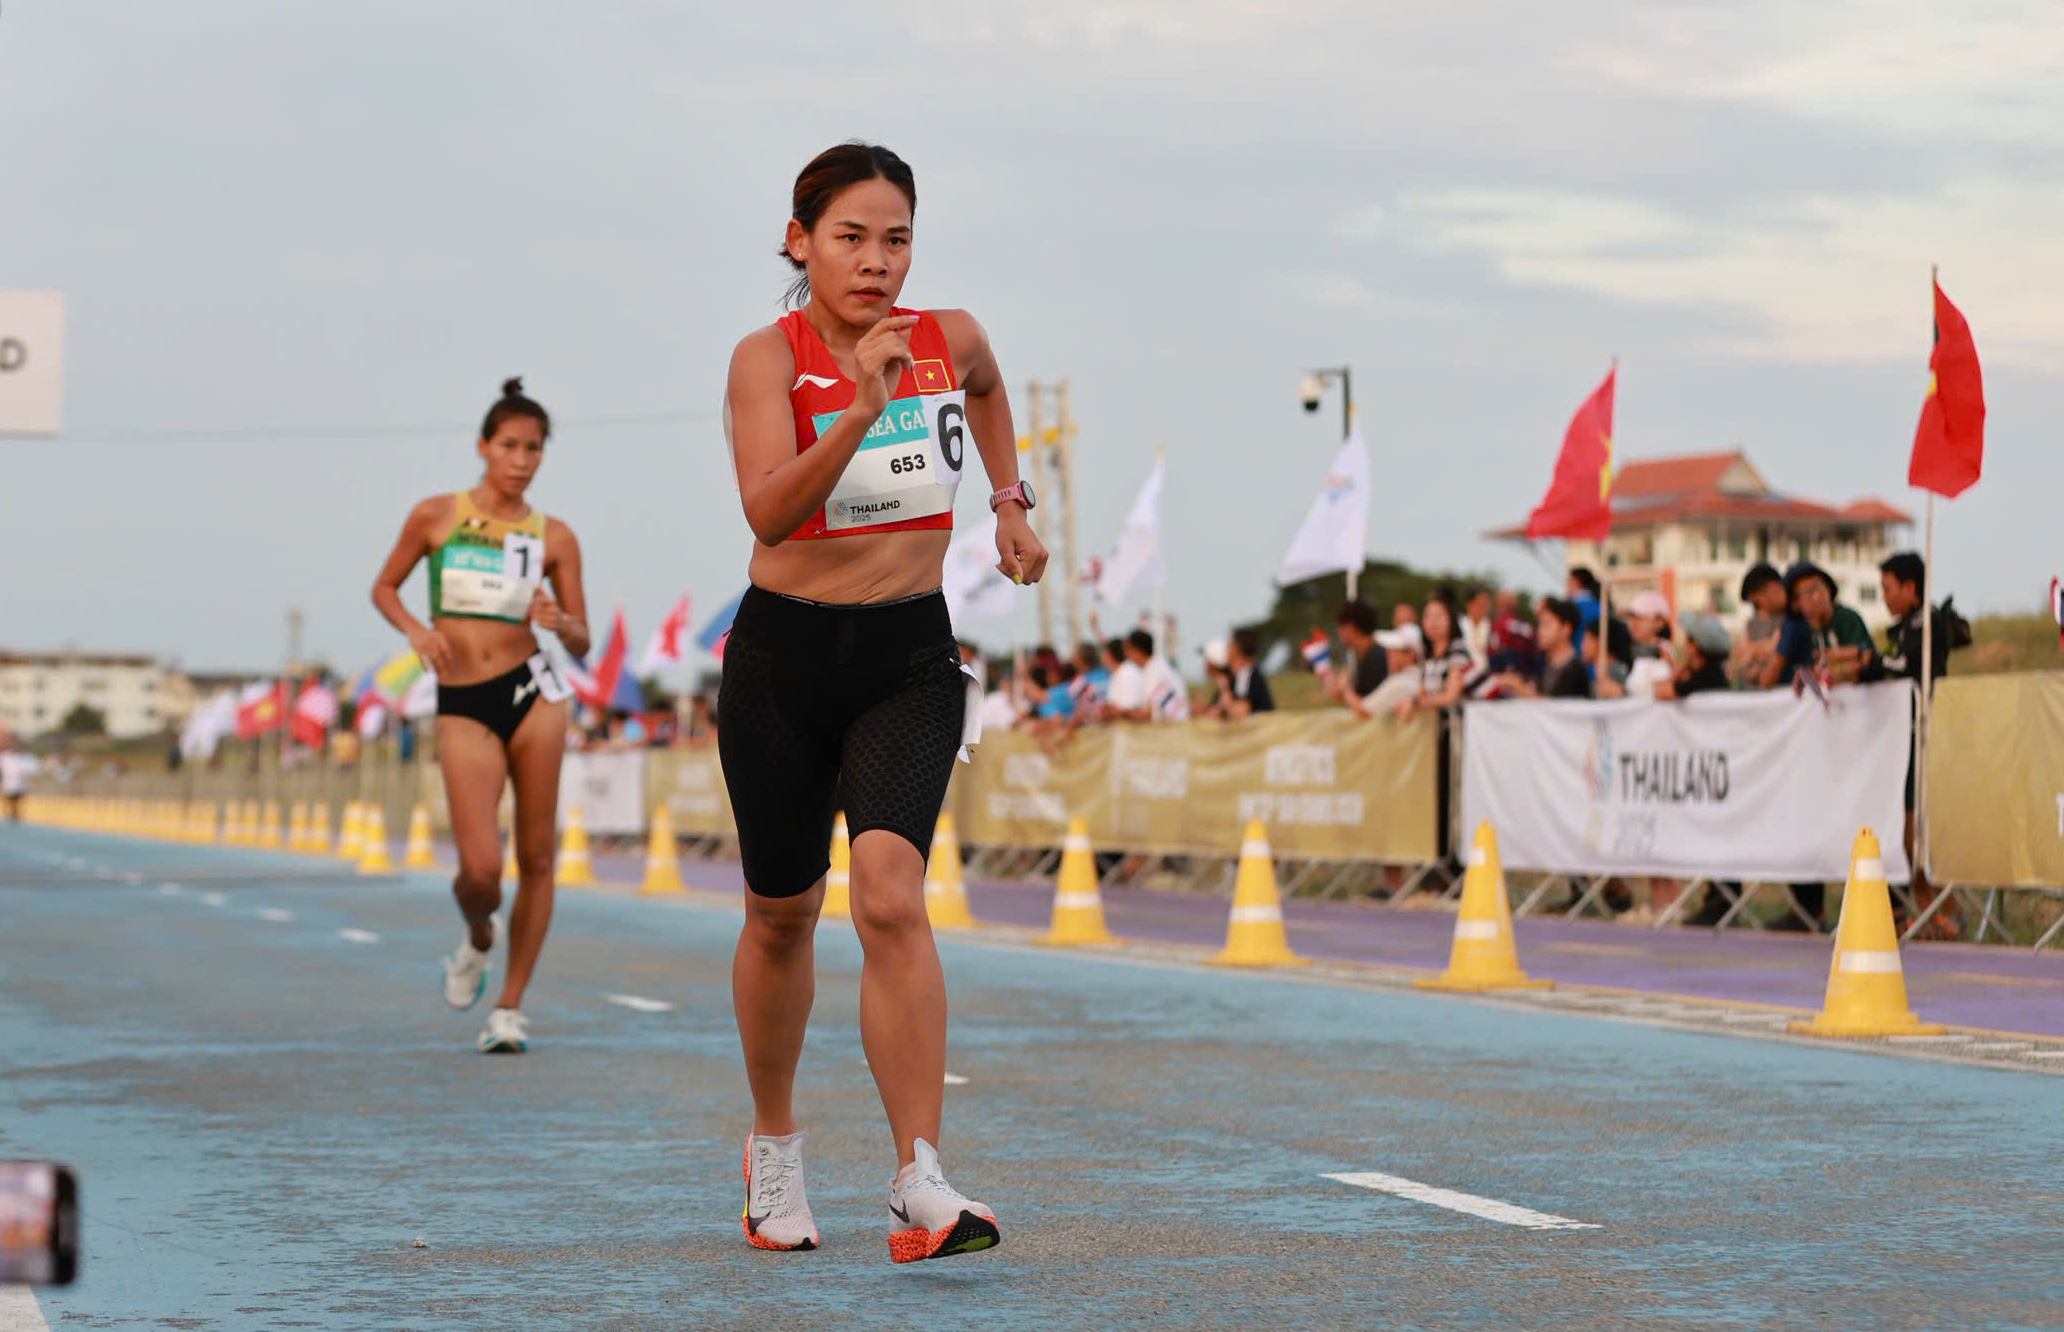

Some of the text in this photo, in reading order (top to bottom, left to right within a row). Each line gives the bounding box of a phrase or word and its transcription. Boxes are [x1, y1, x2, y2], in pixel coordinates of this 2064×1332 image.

[901, 409, 929, 431] GA
[938, 403, 963, 471] 6
[890, 454, 925, 474] 653
[850, 500, 900, 514] THAILAND
[850, 513, 871, 522] 2025
[514, 546, 529, 577] 1
[1619, 751, 1730, 801] THAILAND
